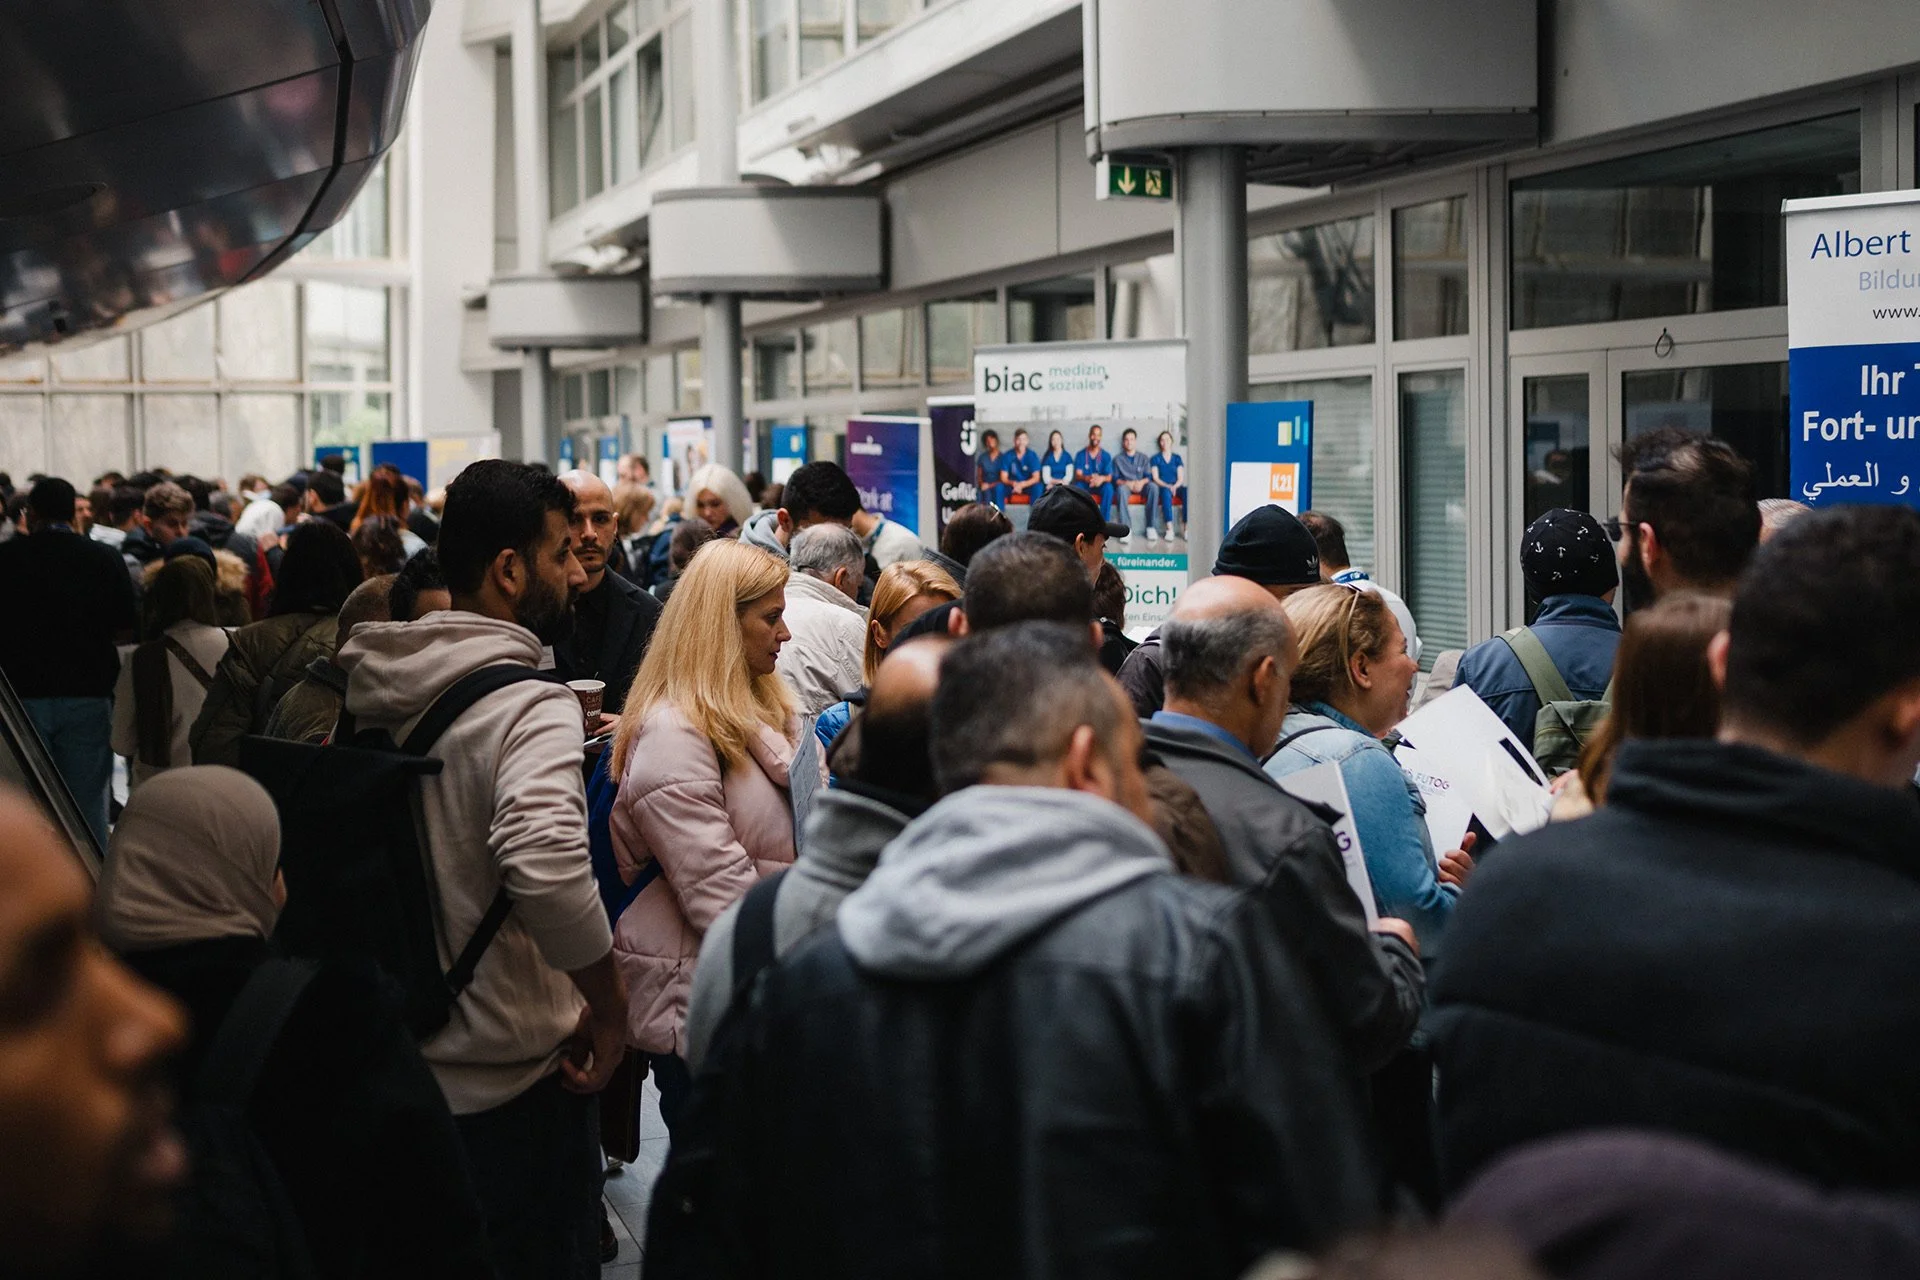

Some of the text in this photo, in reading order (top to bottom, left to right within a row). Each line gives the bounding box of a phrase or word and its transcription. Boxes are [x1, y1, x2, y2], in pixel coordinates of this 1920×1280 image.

[1810, 229, 1912, 259] Albert
[984, 366, 1043, 392] biac
[1048, 362, 1106, 377] medizin
[1861, 365, 1905, 395] Ihr
[1048, 377, 1105, 391] soziales
[1803, 410, 1876, 441] Fort-
[1271, 473, 1293, 492] K21
[1802, 461, 1910, 500] و العملي
